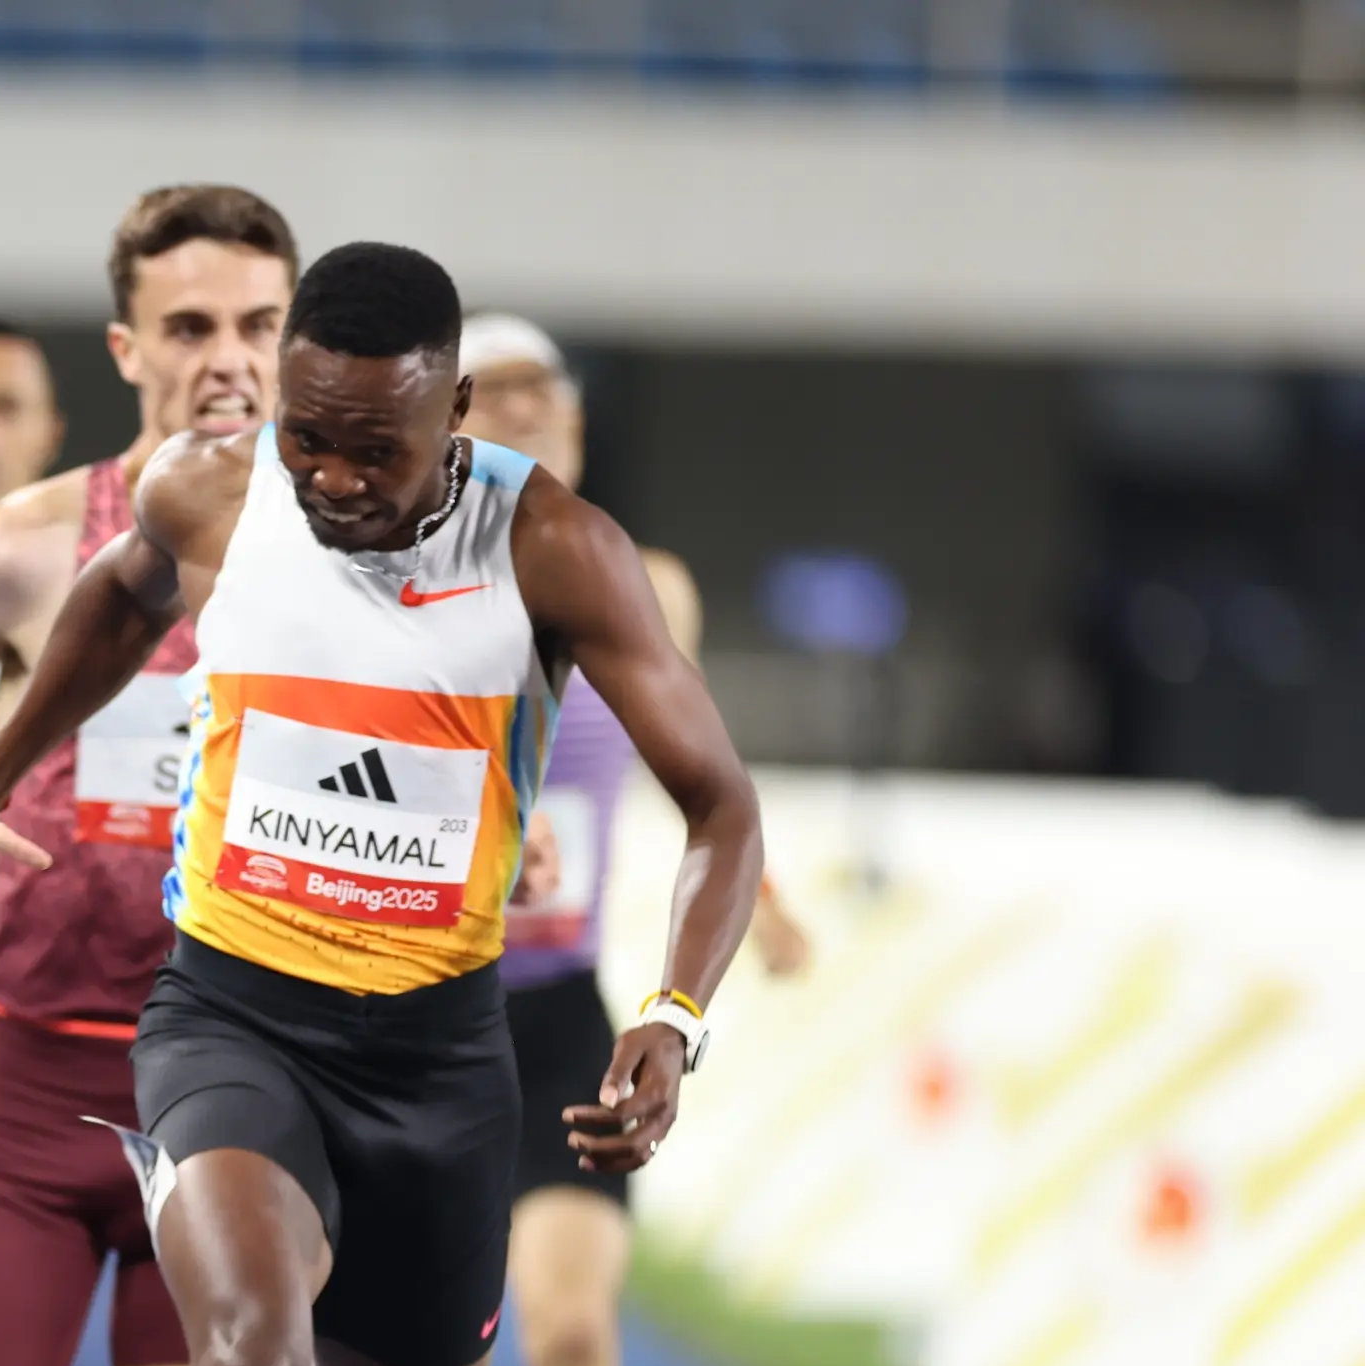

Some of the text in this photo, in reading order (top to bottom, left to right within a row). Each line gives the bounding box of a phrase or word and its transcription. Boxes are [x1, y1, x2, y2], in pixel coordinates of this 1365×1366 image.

[249, 805, 447, 869] KINYAMAL
[439, 818, 468, 834] 203
[306, 872, 440, 914] Beijing2025
